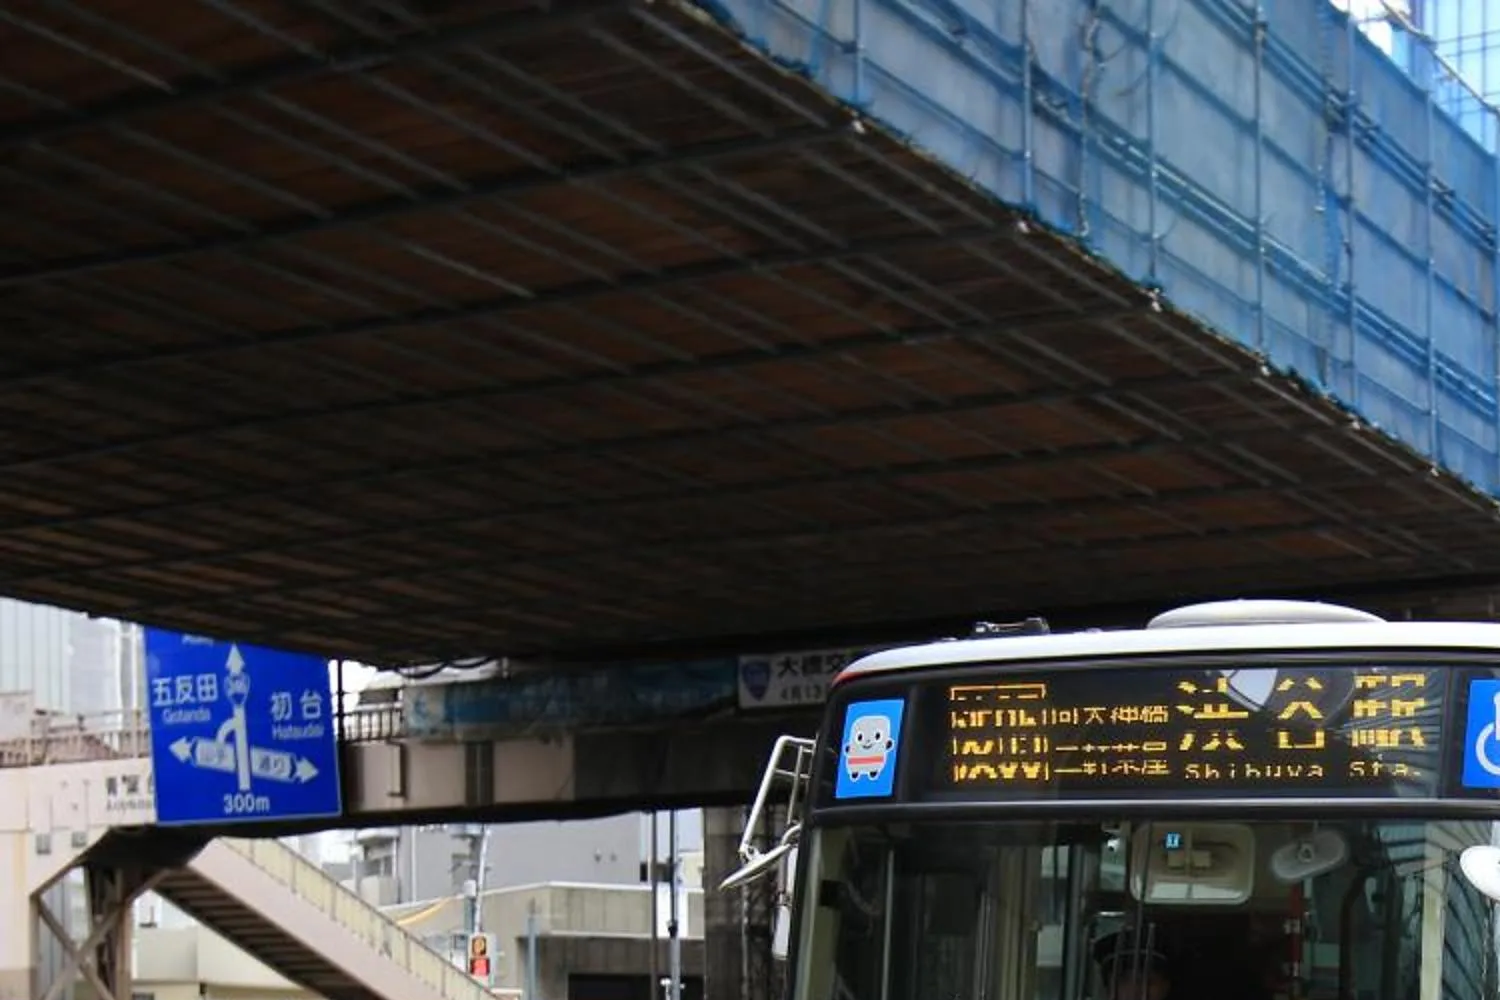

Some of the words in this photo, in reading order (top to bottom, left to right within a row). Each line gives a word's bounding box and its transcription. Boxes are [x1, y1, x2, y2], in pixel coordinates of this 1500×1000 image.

[152, 673, 219, 707] 五反田
[271, 690, 323, 721] 初台
[224, 794, 270, 814] 300m
